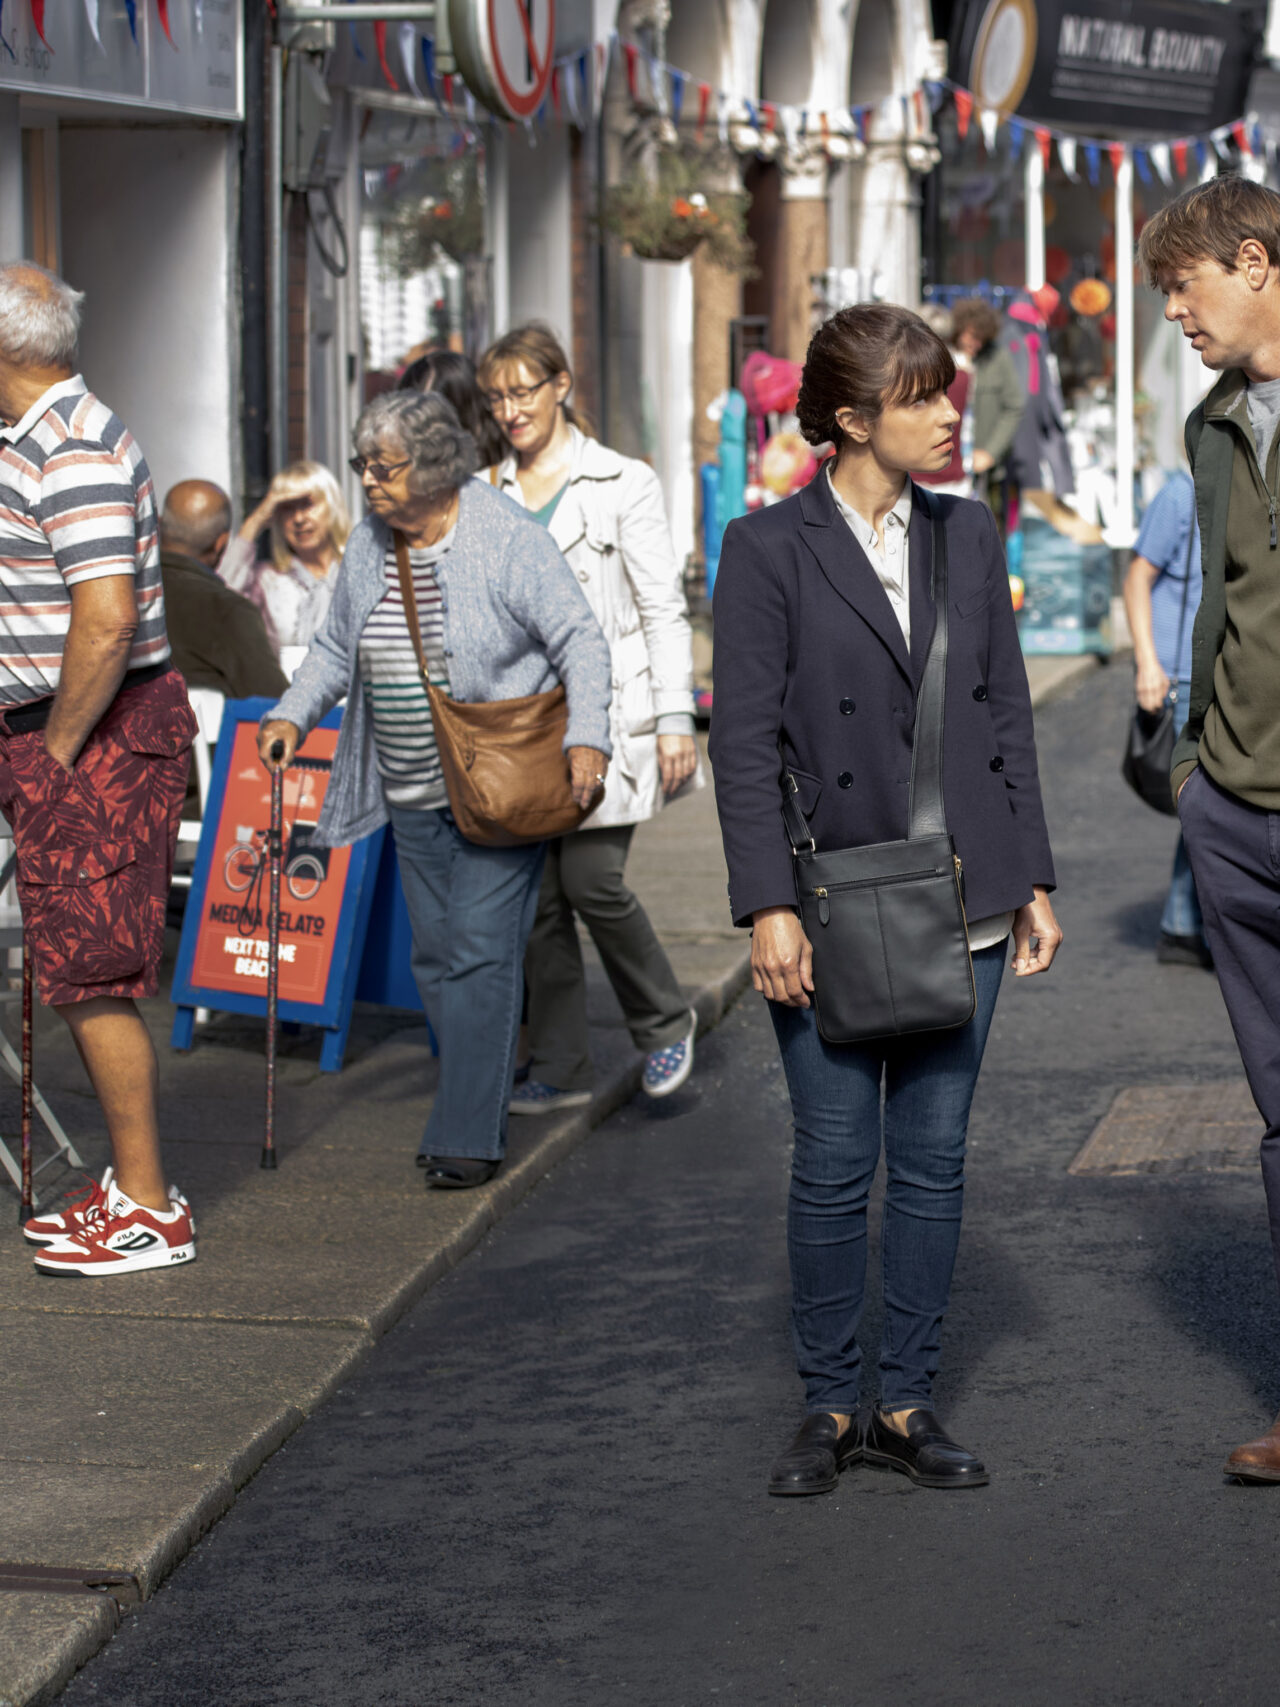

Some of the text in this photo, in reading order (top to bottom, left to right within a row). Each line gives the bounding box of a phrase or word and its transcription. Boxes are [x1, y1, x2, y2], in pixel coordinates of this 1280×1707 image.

[234, 956, 270, 979] BEAC
[117, 1231, 136, 1242] FILA
[171, 1251, 187, 1261] FILA
